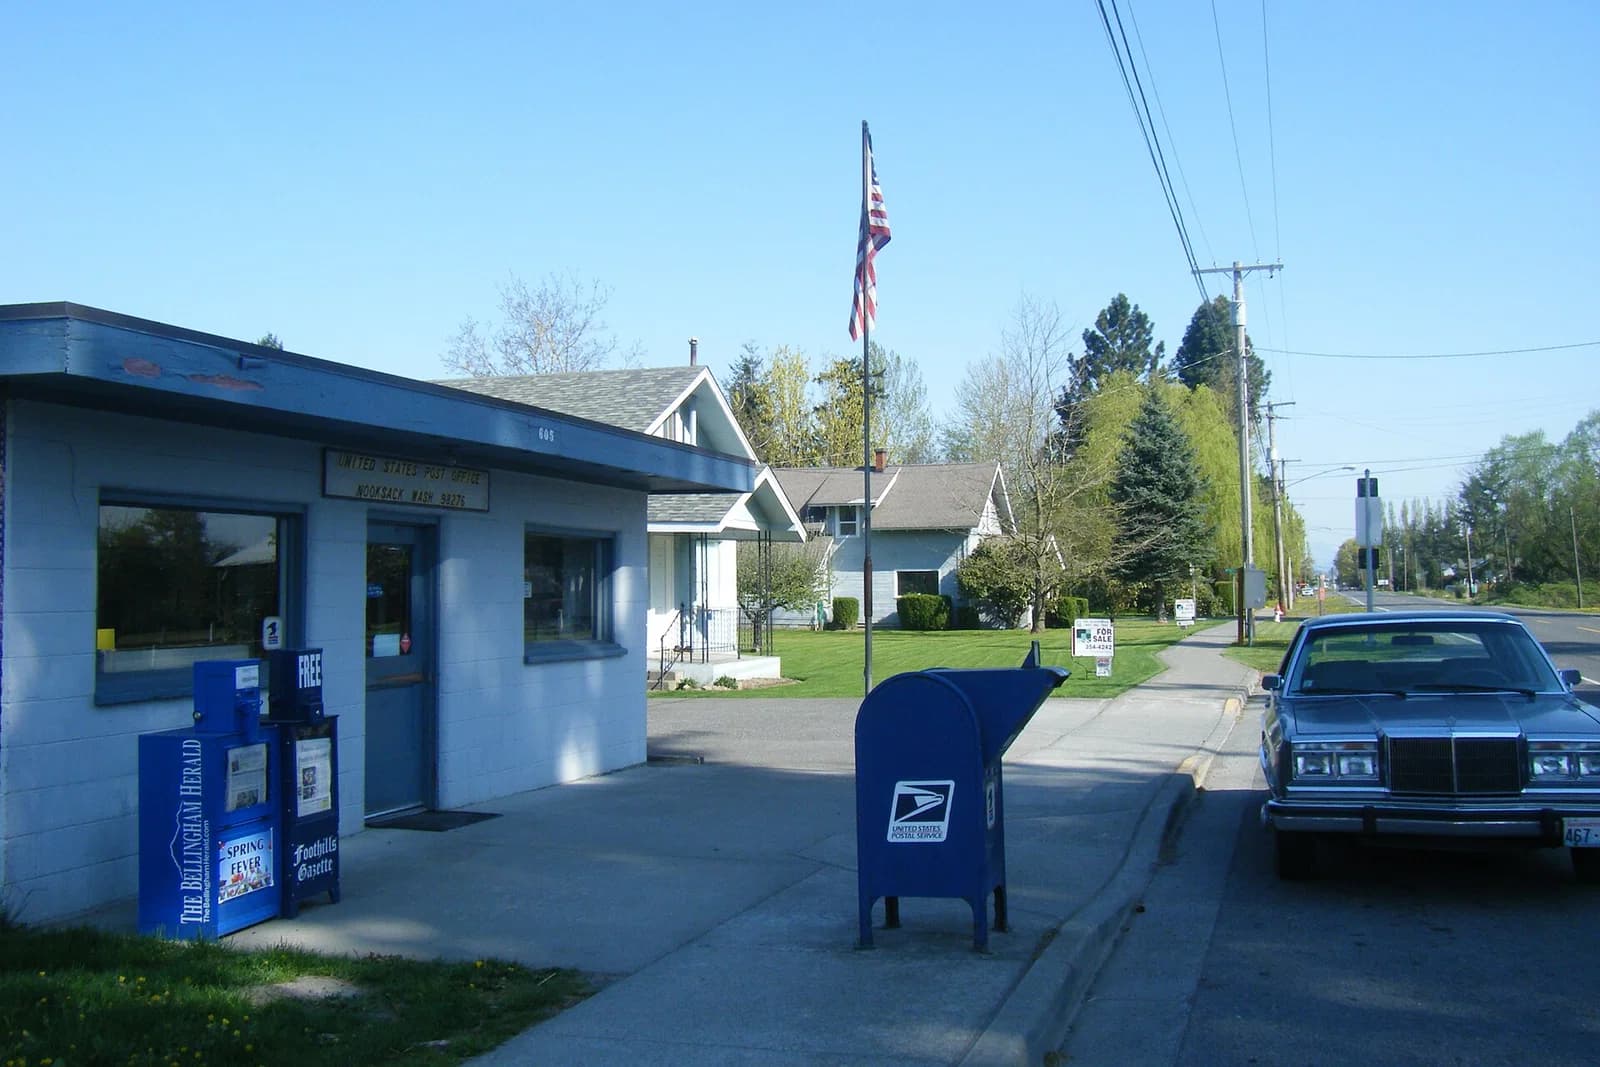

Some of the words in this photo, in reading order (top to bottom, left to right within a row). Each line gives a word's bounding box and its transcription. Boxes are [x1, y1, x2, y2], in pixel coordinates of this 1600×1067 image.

[538, 427, 554, 442] 605
[338, 455, 376, 471] UNITED
[383, 460, 417, 477] STATES
[424, 466, 446, 480] POST
[452, 470, 480, 485] OFFICE
[356, 484, 404, 501] NOOKSACK
[412, 489, 433, 503] WASH
[1092, 635, 1112, 643] SALE
[298, 653, 321, 689] FREE
[179, 739, 202, 796] HERALD
[180, 801, 203, 890] BELLINGHAM
[226, 838, 264, 860] SPRING
[891, 832, 916, 840] POSTAL
[916, 832, 943, 840] SERVICE
[231, 855, 261, 875] FEVER
[293, 836, 337, 867] Foothills
[203, 819, 211, 923] TheBellinghamHerald.com
[297, 857, 333, 882] Gazette
[180, 893, 203, 925] THE
